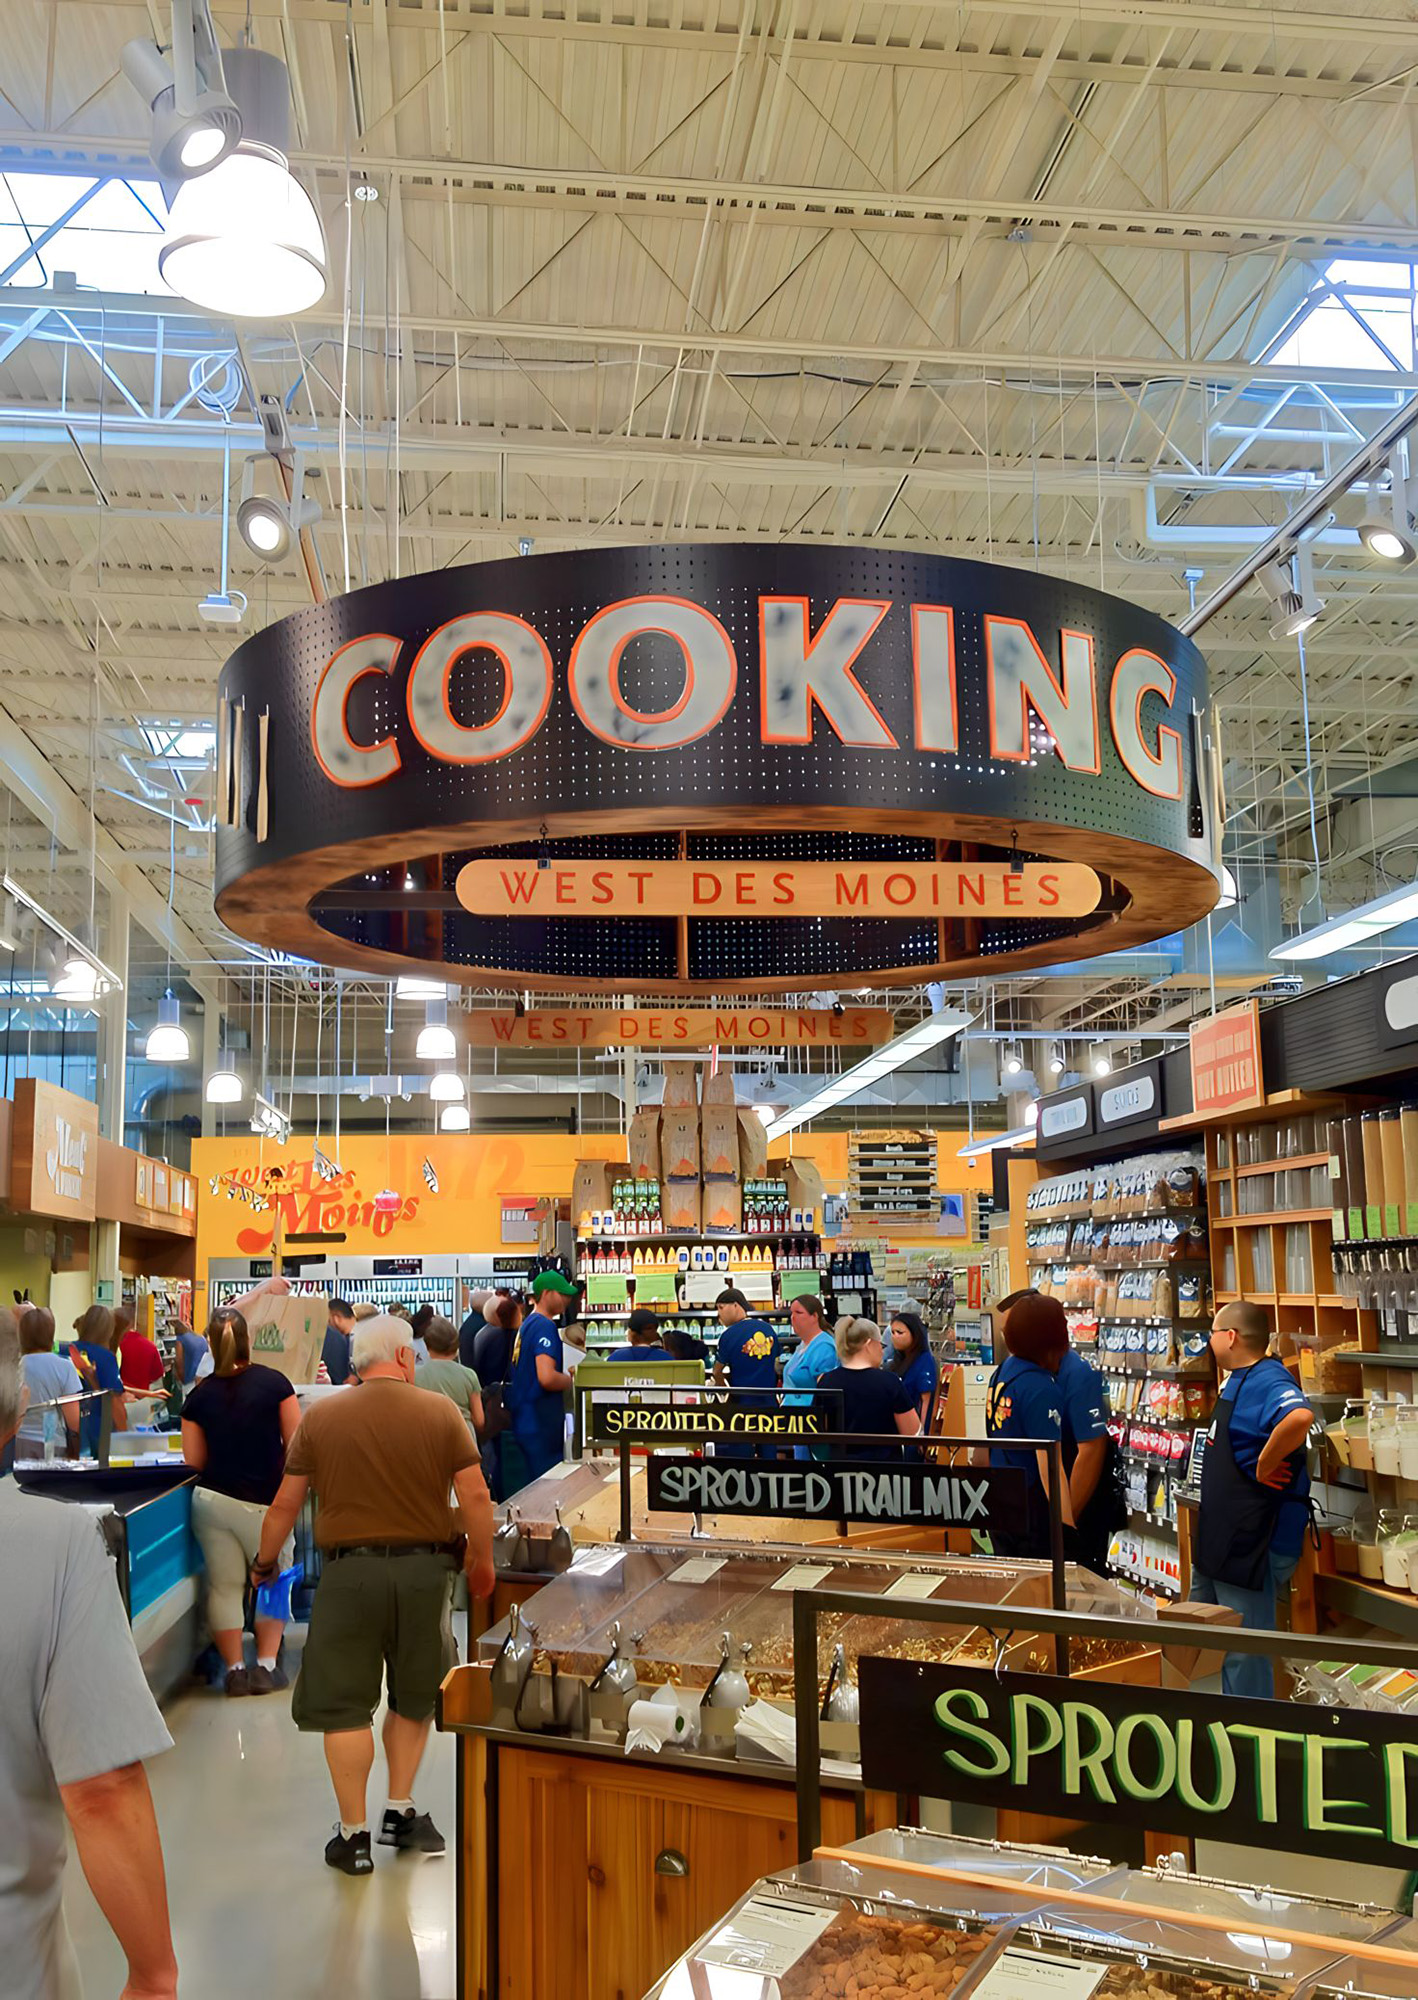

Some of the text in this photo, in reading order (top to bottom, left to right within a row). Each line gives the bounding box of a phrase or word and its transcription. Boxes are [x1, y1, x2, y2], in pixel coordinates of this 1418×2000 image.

[312, 594, 1184, 799] COOKING
[500, 871, 1060, 906] WEST DES MOINES
[491, 1015, 868, 1041] WEST DES MOINES
[606, 1409, 818, 1434] SPROUTED CEREALS
[660, 1465, 831, 1512] SPROUTED
